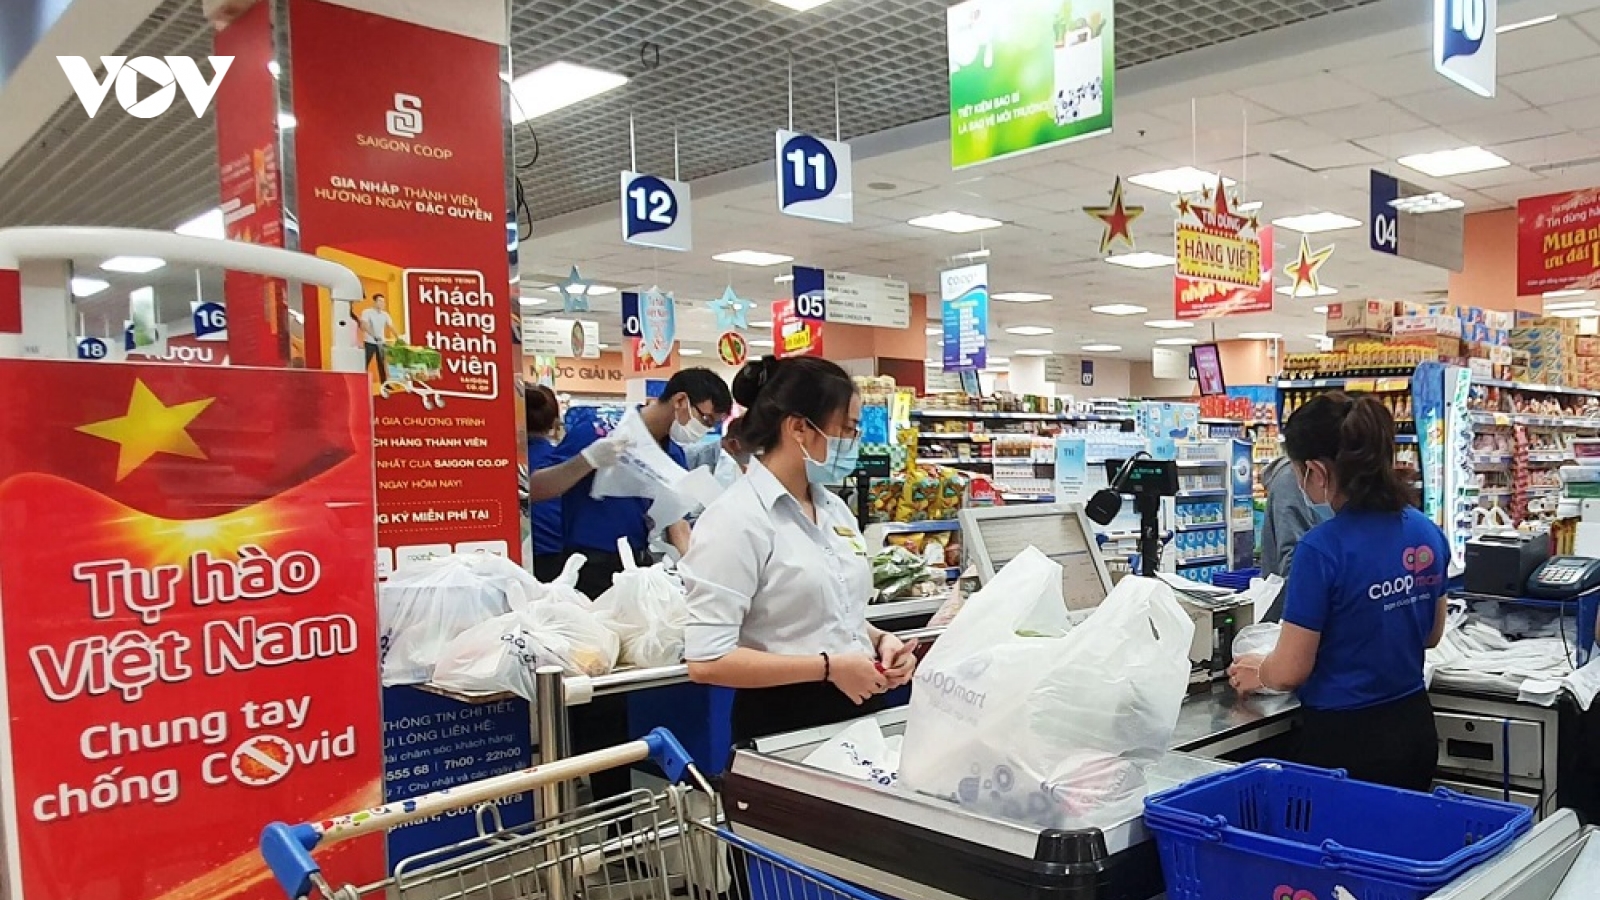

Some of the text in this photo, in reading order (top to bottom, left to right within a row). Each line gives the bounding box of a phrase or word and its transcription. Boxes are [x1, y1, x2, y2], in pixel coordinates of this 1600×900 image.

[356, 133, 410, 153] SAIGON
[787, 149, 826, 191] 11
[330, 175, 356, 190] GIA
[375, 195, 411, 211] NGAY
[629, 187, 672, 225] 12
[1375, 215, 1396, 249] 04
[1546, 215, 1560, 228] Tin
[1543, 228, 1586, 254] Mua
[1184, 236, 1253, 269] HÀNG VIỆT
[419, 285, 494, 307] khách
[798, 294, 823, 318] 05
[198, 310, 227, 327] 16
[435, 306, 495, 333] hàng
[627, 316, 639, 334] 0
[82, 343, 105, 357] 18
[425, 331, 497, 354] thành
[447, 355, 497, 376] viên
[578, 365, 605, 380] GIẢI
[382, 417, 400, 426] GIA
[403, 416, 451, 426] CHƯƠNG
[390, 436, 422, 447] HÀNG
[425, 436, 461, 446] THÀNH
[464, 436, 487, 447] VIÊN
[434, 459, 475, 468] SAIGON
[476, 459, 509, 467] CO.OP
[379, 478, 463, 489] NGAY HÔM NAY!
[447, 508, 468, 521] PHÍ
[470, 510, 489, 521] TẠI
[73, 544, 321, 624] Tự hào
[29, 630, 192, 702] Việt
[204, 615, 357, 676] Nam
[79, 695, 311, 760] Chung tay
[383, 713, 431, 732] THÔNG
[435, 712, 457, 723] TIN
[459, 706, 483, 719] CHI
[399, 729, 437, 747] LÒNG
[441, 723, 470, 739] LIÊN
[433, 745, 451, 755] sóc
[455, 738, 486, 750] khách
[413, 764, 430, 775] 68
[444, 756, 474, 769] 7h00
[485, 747, 521, 762] 22h00
[32, 766, 179, 822] chống
